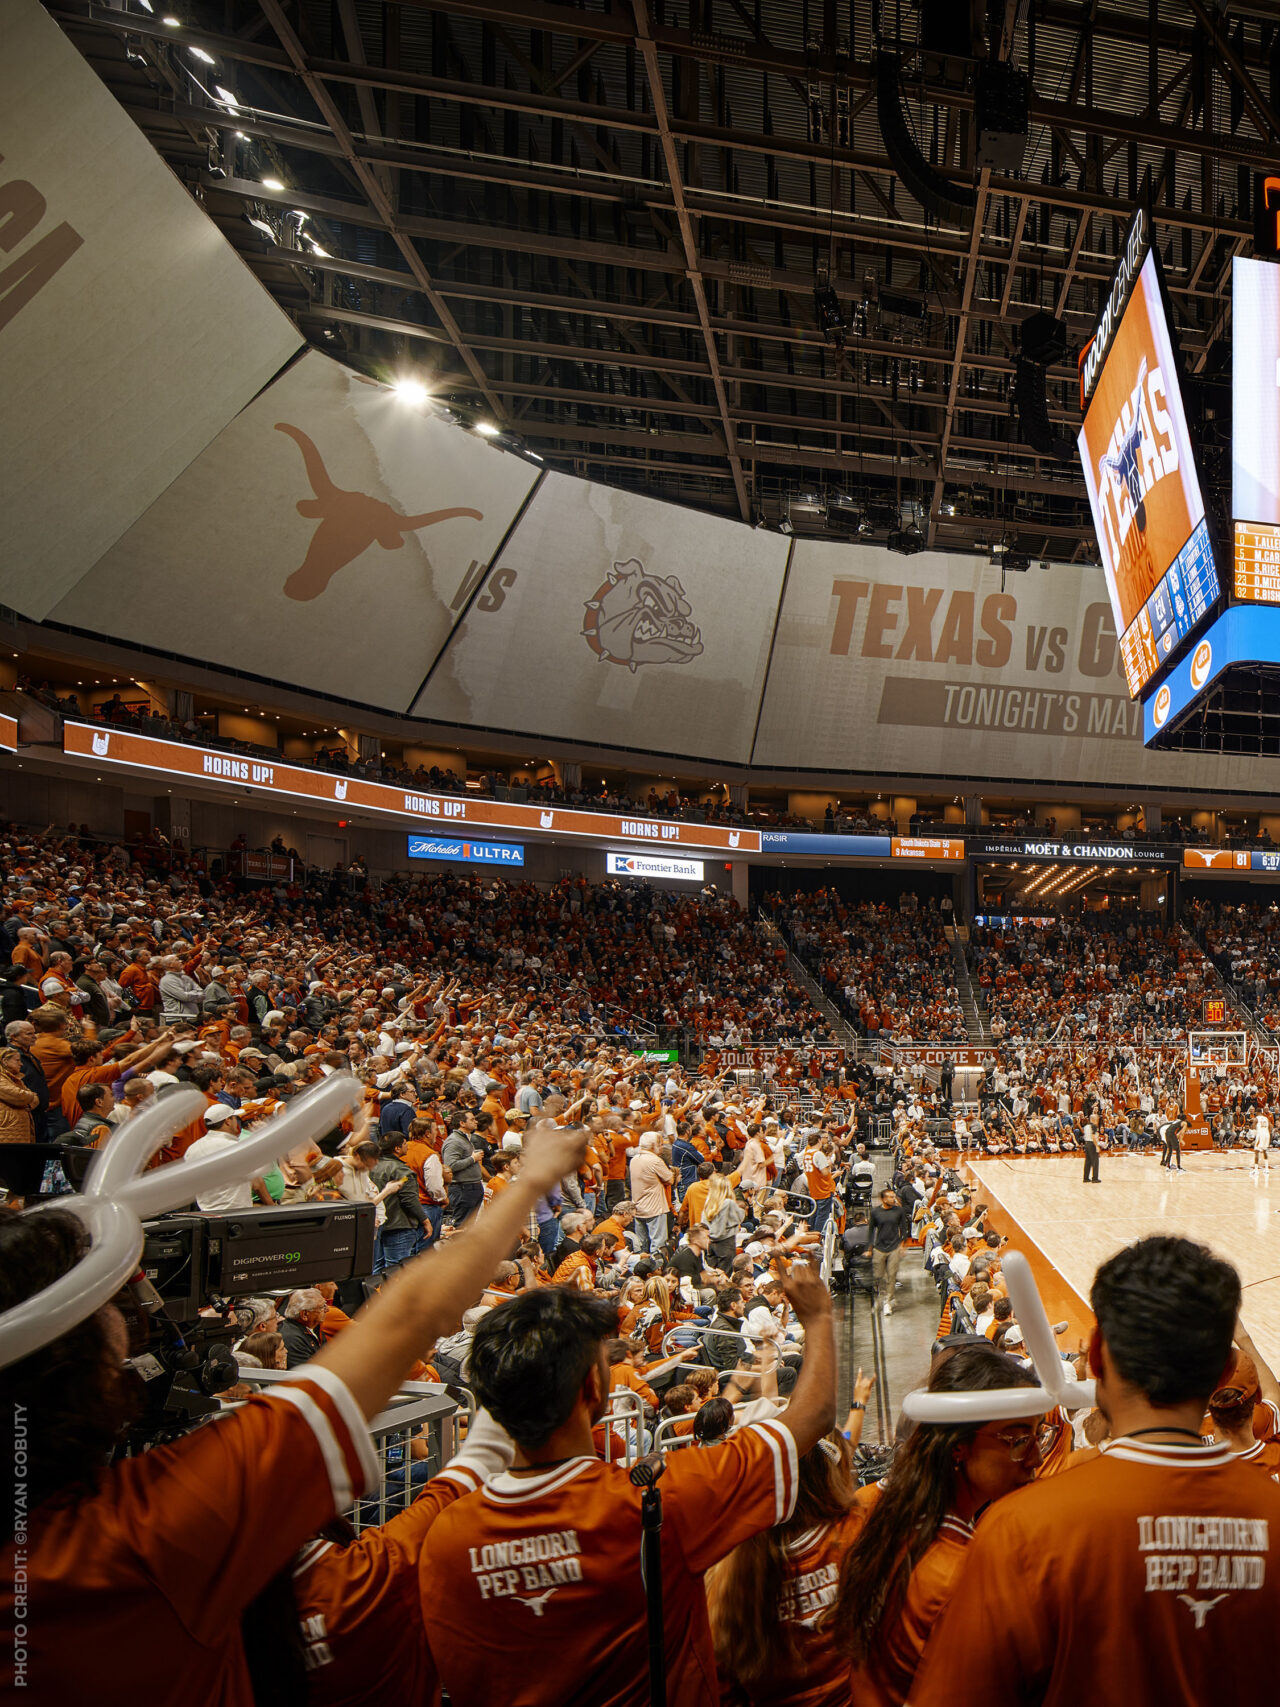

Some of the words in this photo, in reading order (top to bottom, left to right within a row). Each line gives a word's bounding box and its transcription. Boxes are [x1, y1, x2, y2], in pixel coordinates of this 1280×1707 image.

[1084, 292, 1113, 398] MOODY
[1112, 208, 1143, 317] CENTER
[1254, 563, 1280, 576] S.RICE
[448, 559, 517, 613] VS
[829, 579, 1018, 668] TEXAS
[1025, 625, 1068, 673] VS
[1076, 601, 1129, 682] G
[943, 685, 1079, 732] TONIGHT'S
[203, 755, 249, 780] HORNS
[252, 765, 274, 784] UP!
[404, 795, 440, 815] HORNS
[443, 801, 466, 817] UP!
[621, 821, 659, 838] HORNS
[661, 825, 680, 840] UP!
[763, 834, 788, 842] RASIR
[410, 841, 460, 856] Michelob
[473, 846, 523, 861] ULTRA
[900, 848, 925, 857] Arkansas
[1024, 842, 1060, 856] MOËT
[1062, 845, 1072, 856] &
[1073, 846, 1133, 858] CHANDON
[1134, 851, 1165, 859] LOUNGE
[1236, 853, 1247, 866] 81
[1262, 856, 1280, 867] 6:07
[637, 860, 673, 874] Frontier
[673, 864, 697, 875] Bank
[1208, 1009, 1222, 1021] 30
[1137, 1516, 1270, 1551] LONGHORN
[468, 1529, 582, 1573] LONGHORN
[477, 1569, 520, 1599] PEP
[520, 1557, 583, 1590] BAND
[1145, 1555, 1197, 1592] PEP
[1197, 1555, 1265, 1590] BAND
